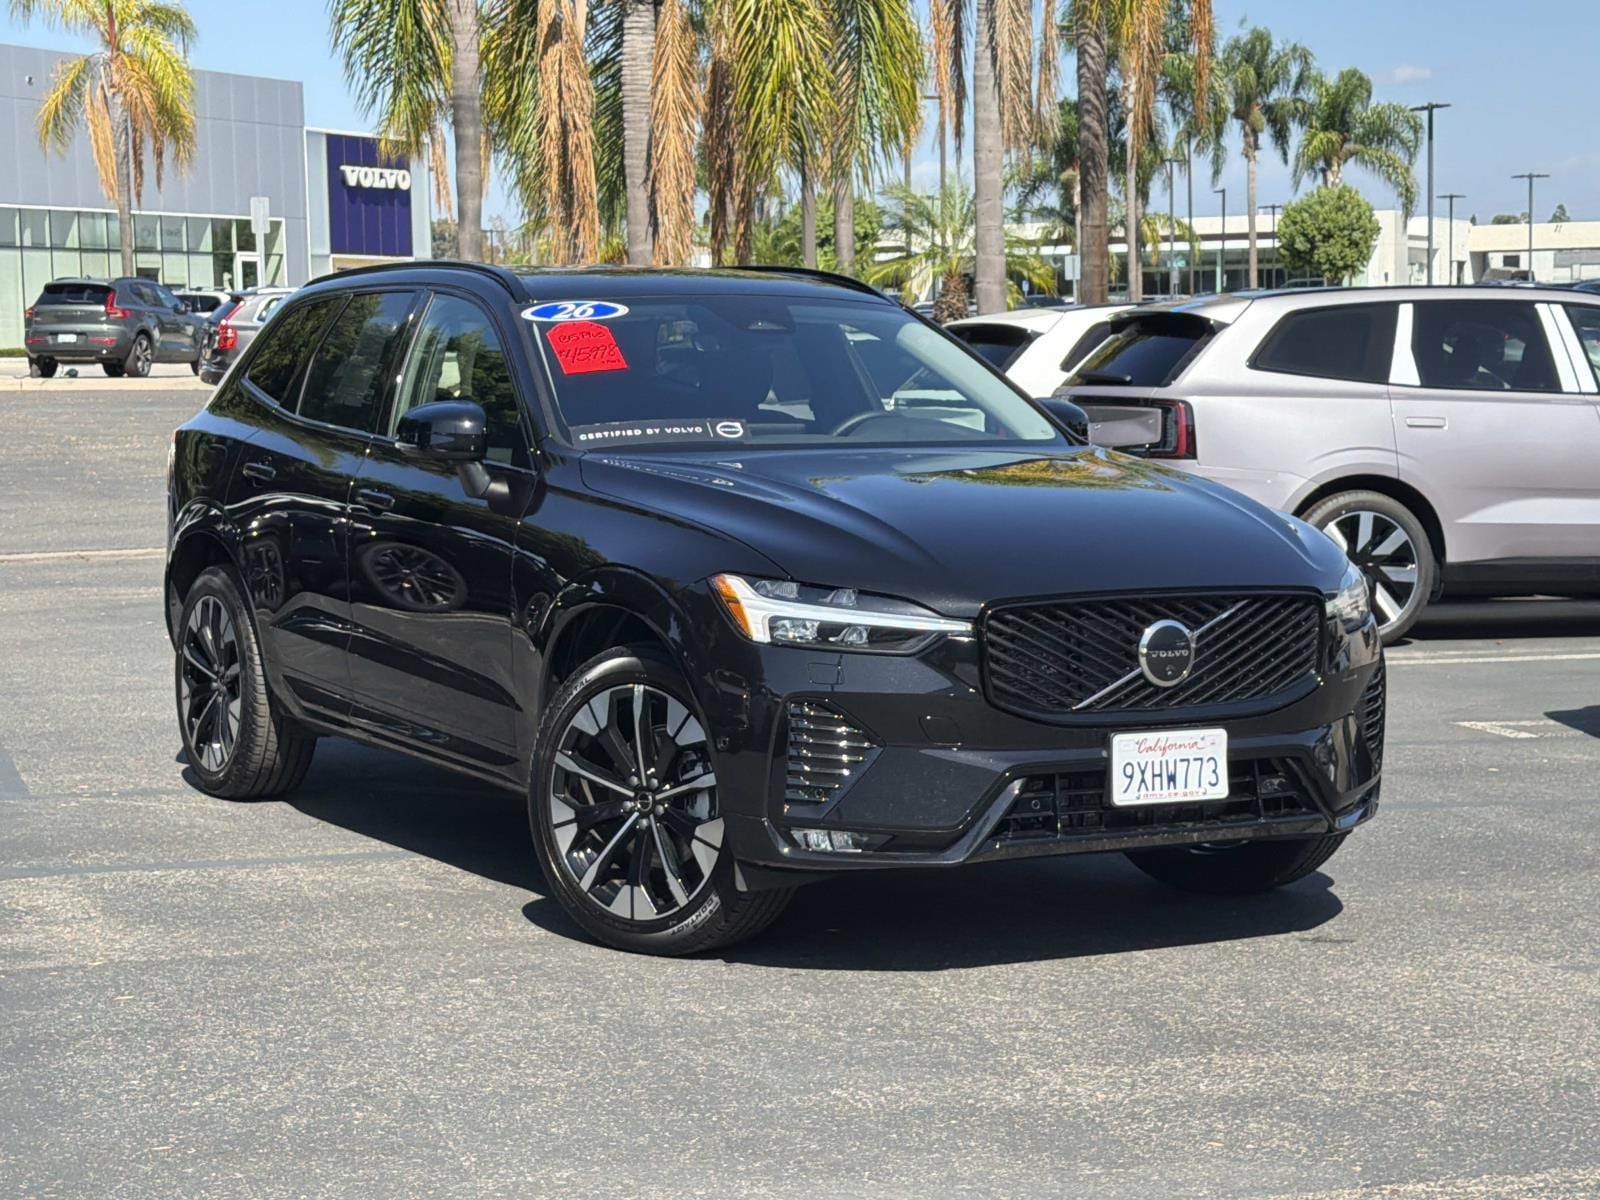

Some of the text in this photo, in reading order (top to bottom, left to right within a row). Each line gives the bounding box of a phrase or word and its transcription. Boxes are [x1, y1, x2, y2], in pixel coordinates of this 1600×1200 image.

[339, 165, 411, 190] VOLVO
[553, 303, 595, 318] 26
[579, 426, 703, 441] CERTIFIED BY VOLVO
[1149, 649, 1189, 658] VOLVO
[1138, 737, 1206, 757] California
[1122, 756, 1219, 794] 9XHW773
